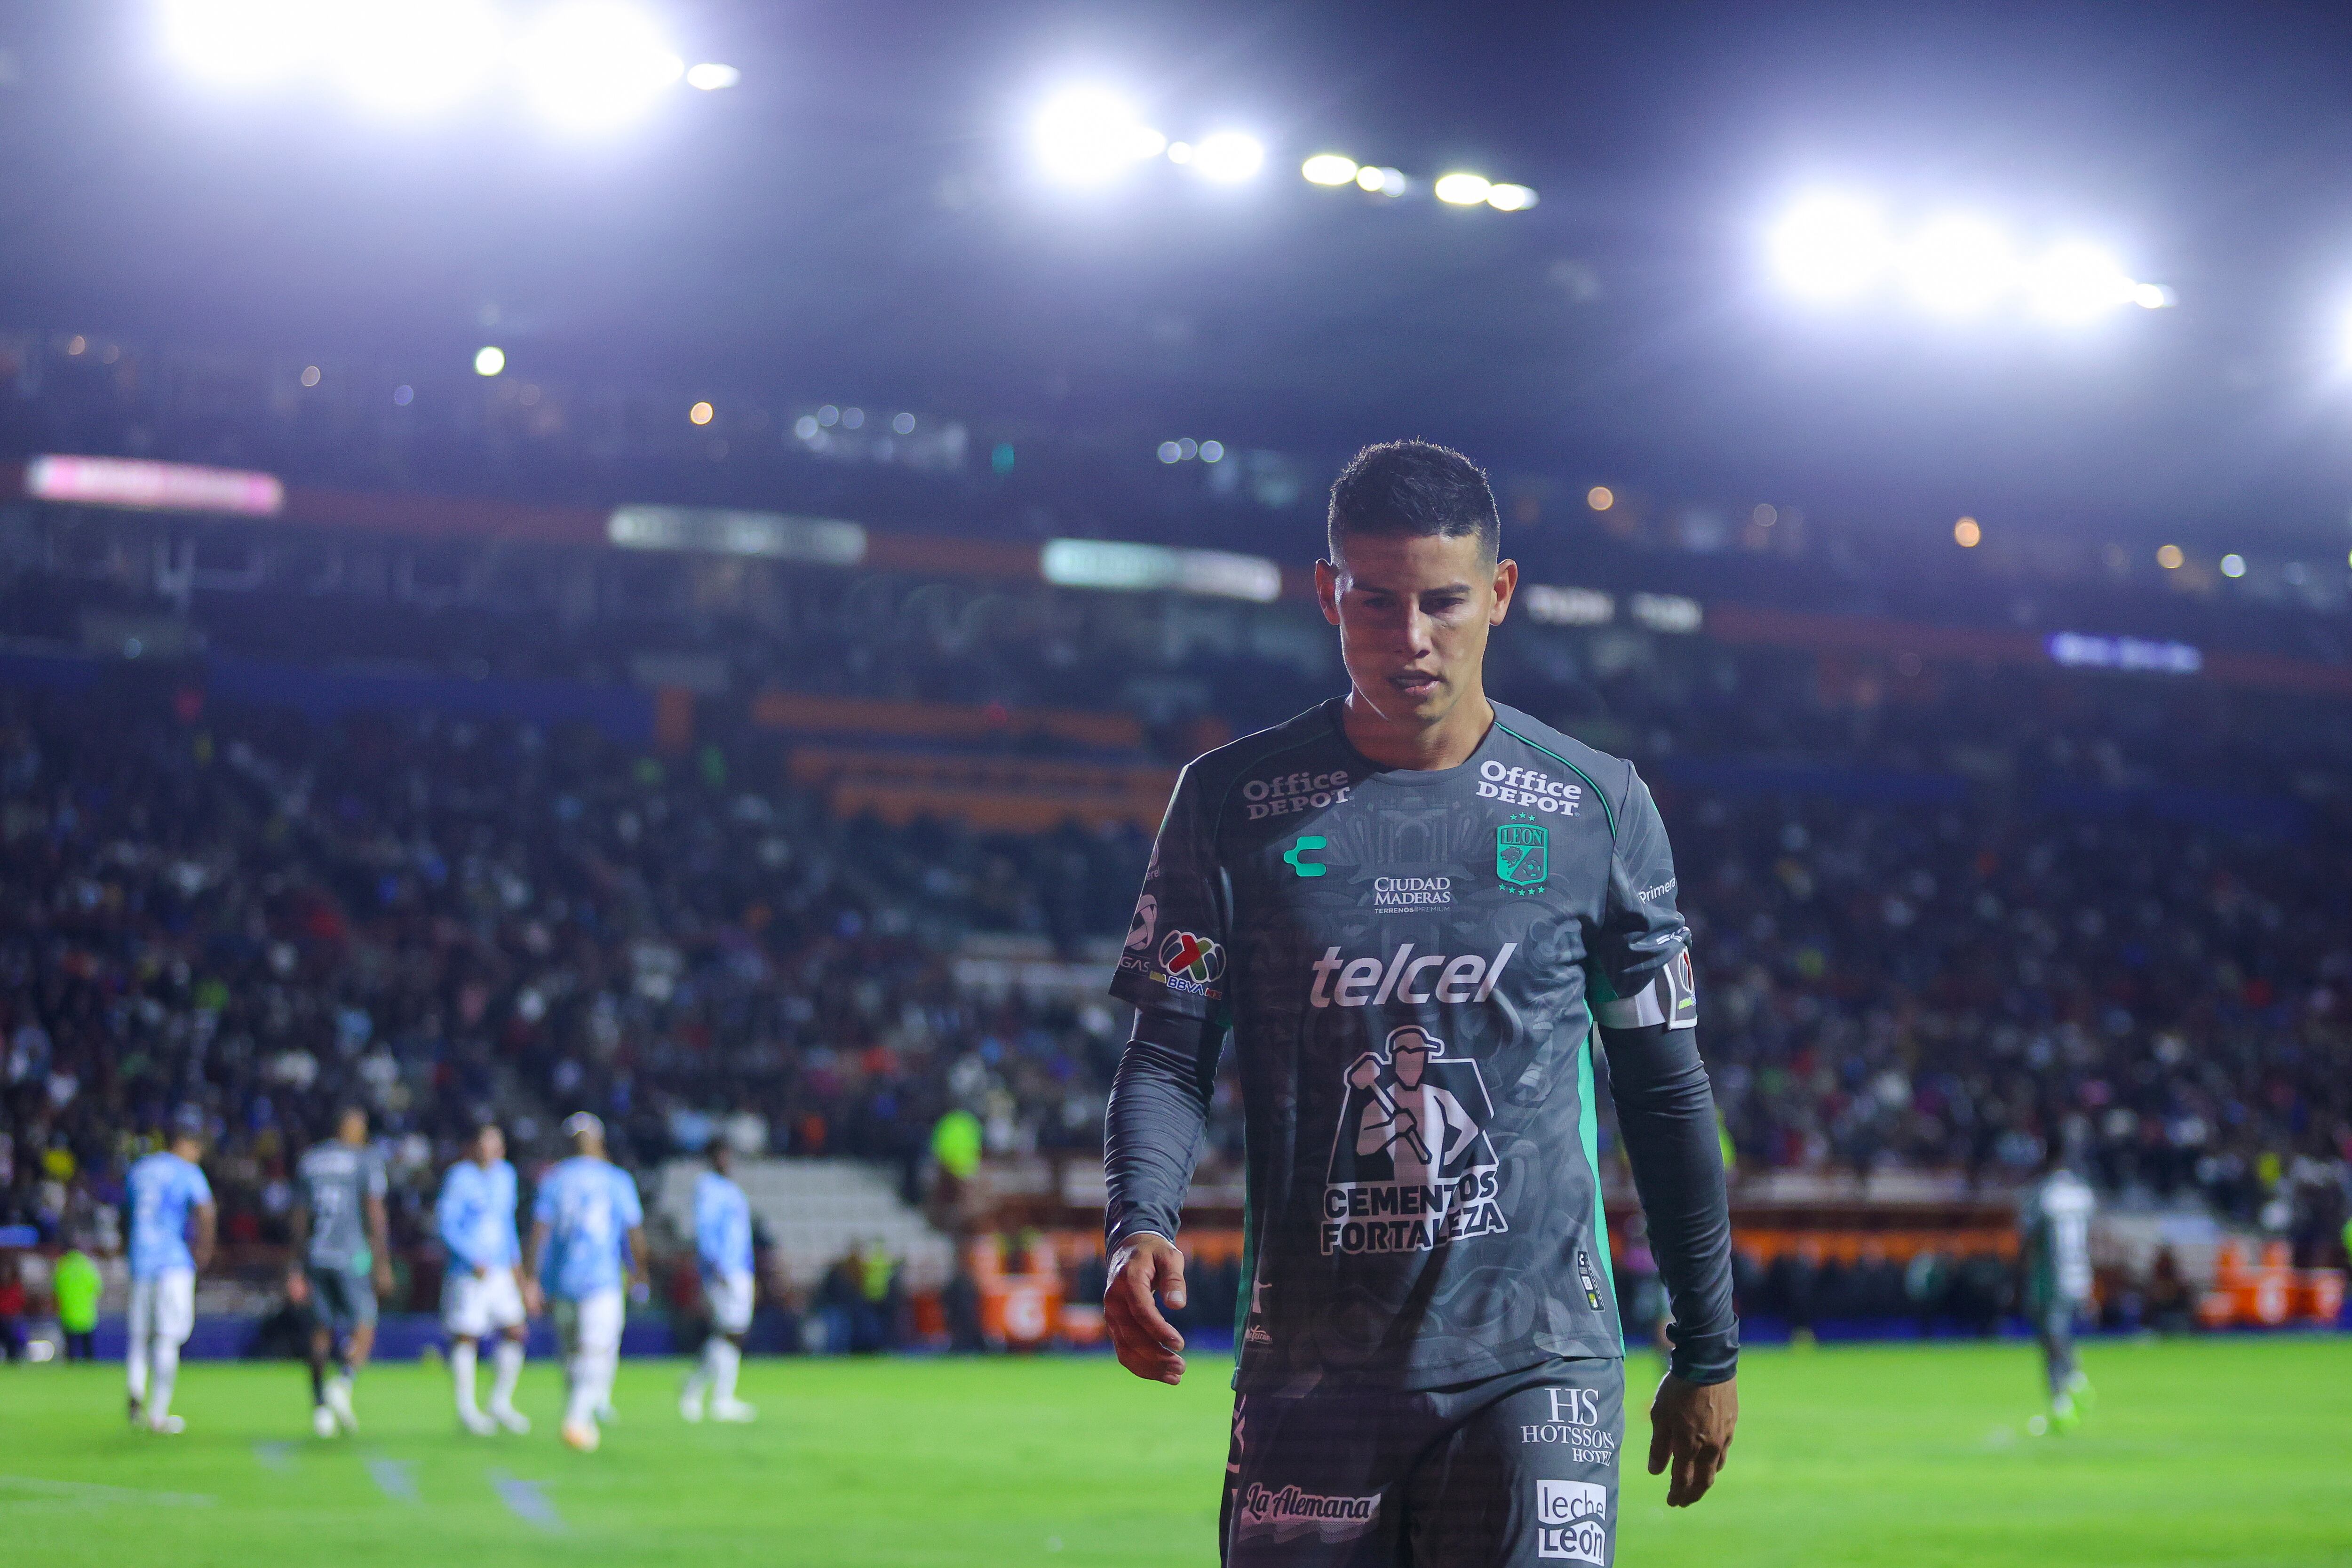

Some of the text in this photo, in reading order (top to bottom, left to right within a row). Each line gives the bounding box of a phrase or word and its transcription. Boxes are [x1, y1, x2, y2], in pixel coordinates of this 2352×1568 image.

[1243, 770, 1349, 801] Office
[1480, 760, 1582, 800] Office
[1247, 786, 1351, 820] DEPOT
[1476, 780, 1579, 816] DEPOT
[1374, 877, 1451, 892] CIUDAD
[1374, 891, 1450, 905] MADERAS
[1638, 877, 1676, 904] Primera
[1167, 975, 1204, 996] BBVA
[1310, 942, 1518, 1008] telcel
[1324, 1170, 1497, 1218] CEMENTOS
[1321, 1201, 1508, 1255] FORTALEZA
[1544, 1388, 1599, 1427] HS
[1521, 1425, 1615, 1449] HOTSSON
[1248, 1484, 1372, 1521] La Alemana
[1543, 1486, 1604, 1519] leche
